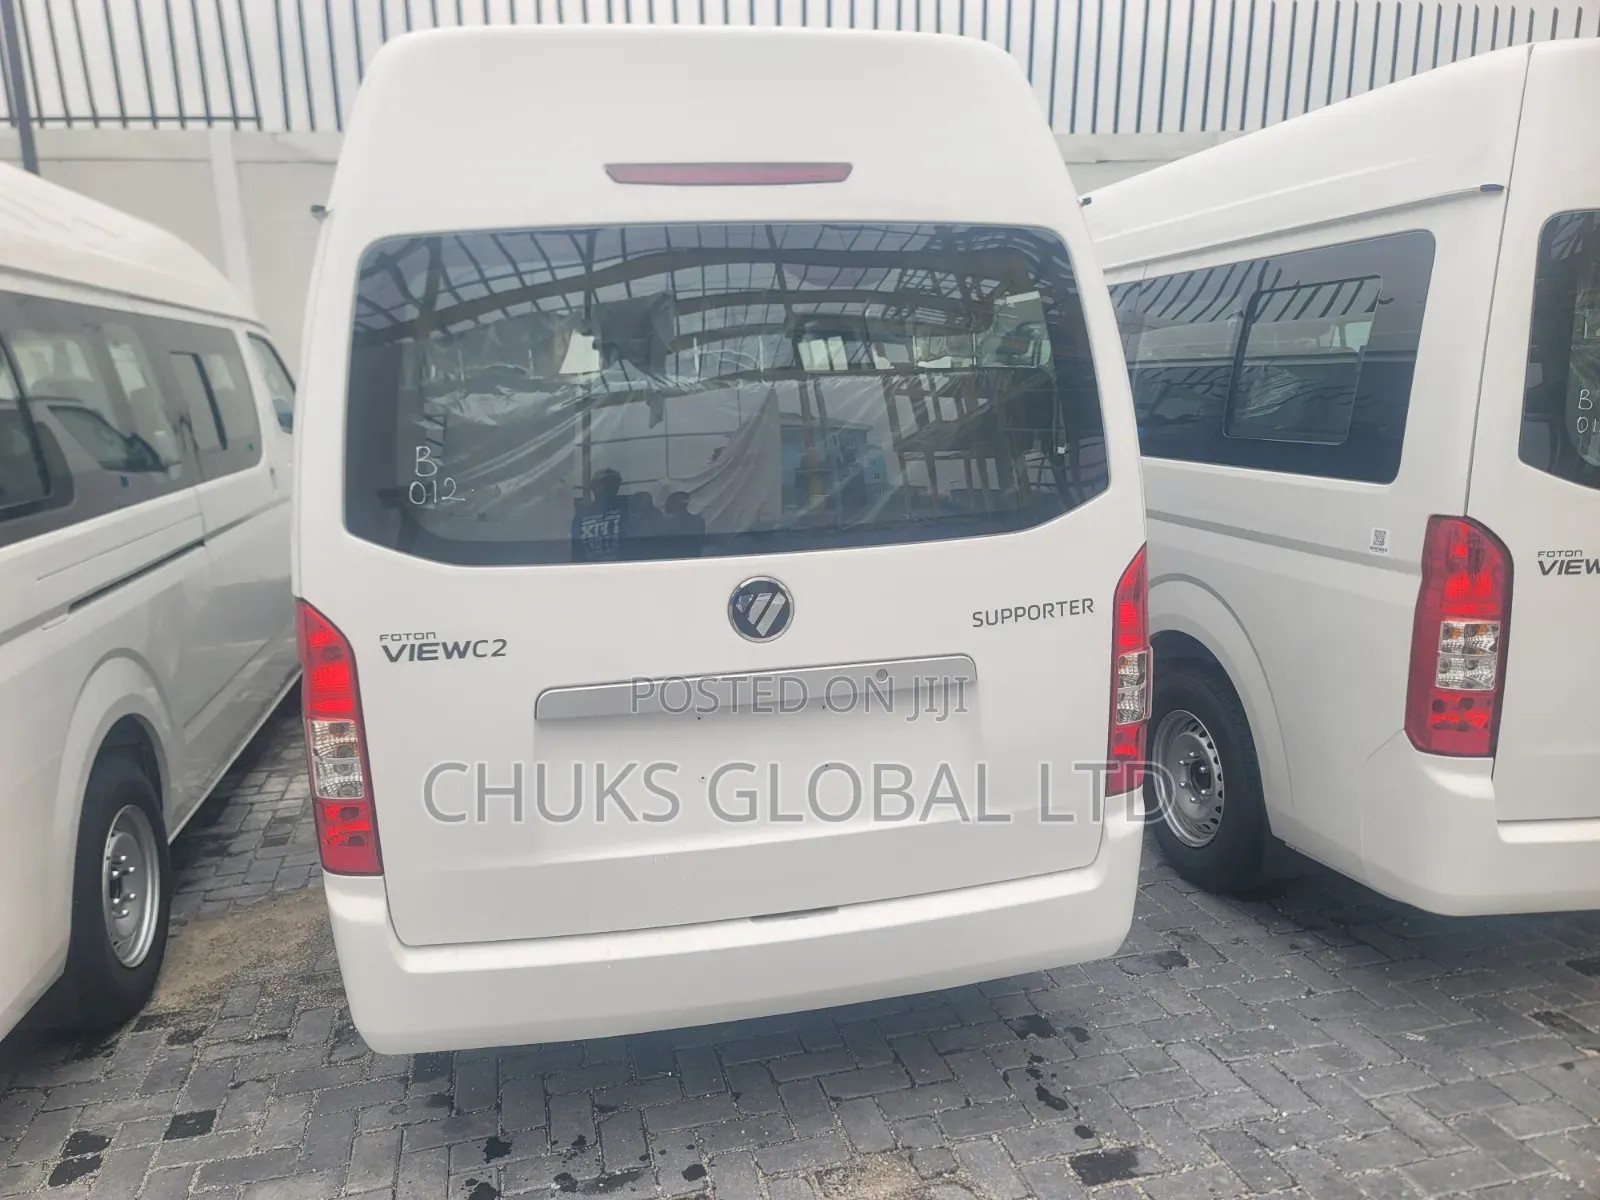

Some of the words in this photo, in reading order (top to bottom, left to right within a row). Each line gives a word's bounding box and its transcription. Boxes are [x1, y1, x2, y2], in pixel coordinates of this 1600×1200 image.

[1578, 388, 1593, 410] B
[1576, 416, 1600, 433] 01
[414, 445, 438, 477] B
[408, 477, 466, 504] 012
[1537, 549, 1583, 558] FOTON
[972, 597, 1094, 628] SUPPORTER
[379, 631, 436, 642] FOTON
